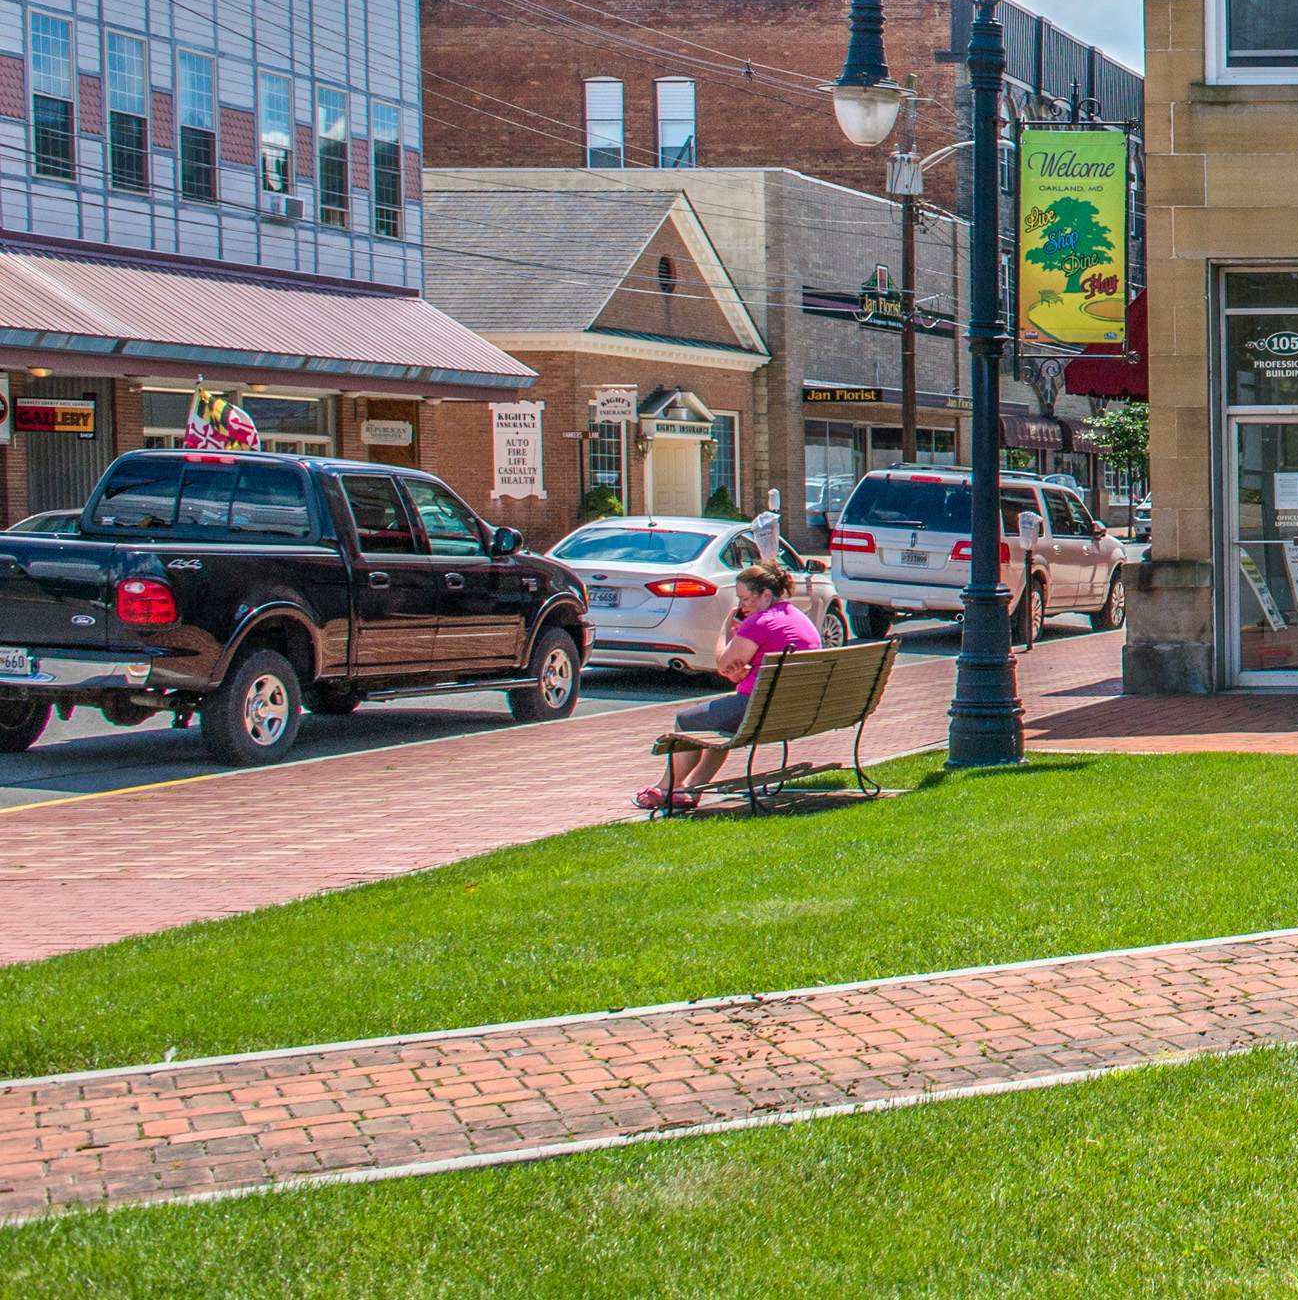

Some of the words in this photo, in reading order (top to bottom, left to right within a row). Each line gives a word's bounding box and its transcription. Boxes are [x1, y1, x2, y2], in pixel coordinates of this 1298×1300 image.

[1027, 149, 1116, 179] Welcome
[1039, 184, 1085, 194] OAKLAND,
[1088, 185, 1104, 193] MD
[1025, 206, 1057, 233] Live
[1043, 227, 1079, 256] Shop
[1062, 251, 1099, 277] Dine
[1081, 273, 1119, 300] Play
[807, 389, 831, 401] Jan
[836, 390, 877, 401] Florist
[600, 396, 631, 408] KIGHT'S
[18, 410, 91, 427] GALLERY
[497, 412, 536, 421] KIGHT'S
[496, 421, 537, 429] INSURANCE
[679, 425, 709, 435] INSURANCE
[505, 438, 530, 447] AUTO
[507, 448, 528, 457] FIRE
[508, 457, 528, 466] LIFE
[498, 466, 537, 475] CASUALTY
[500, 476, 536, 485] HEALTH
